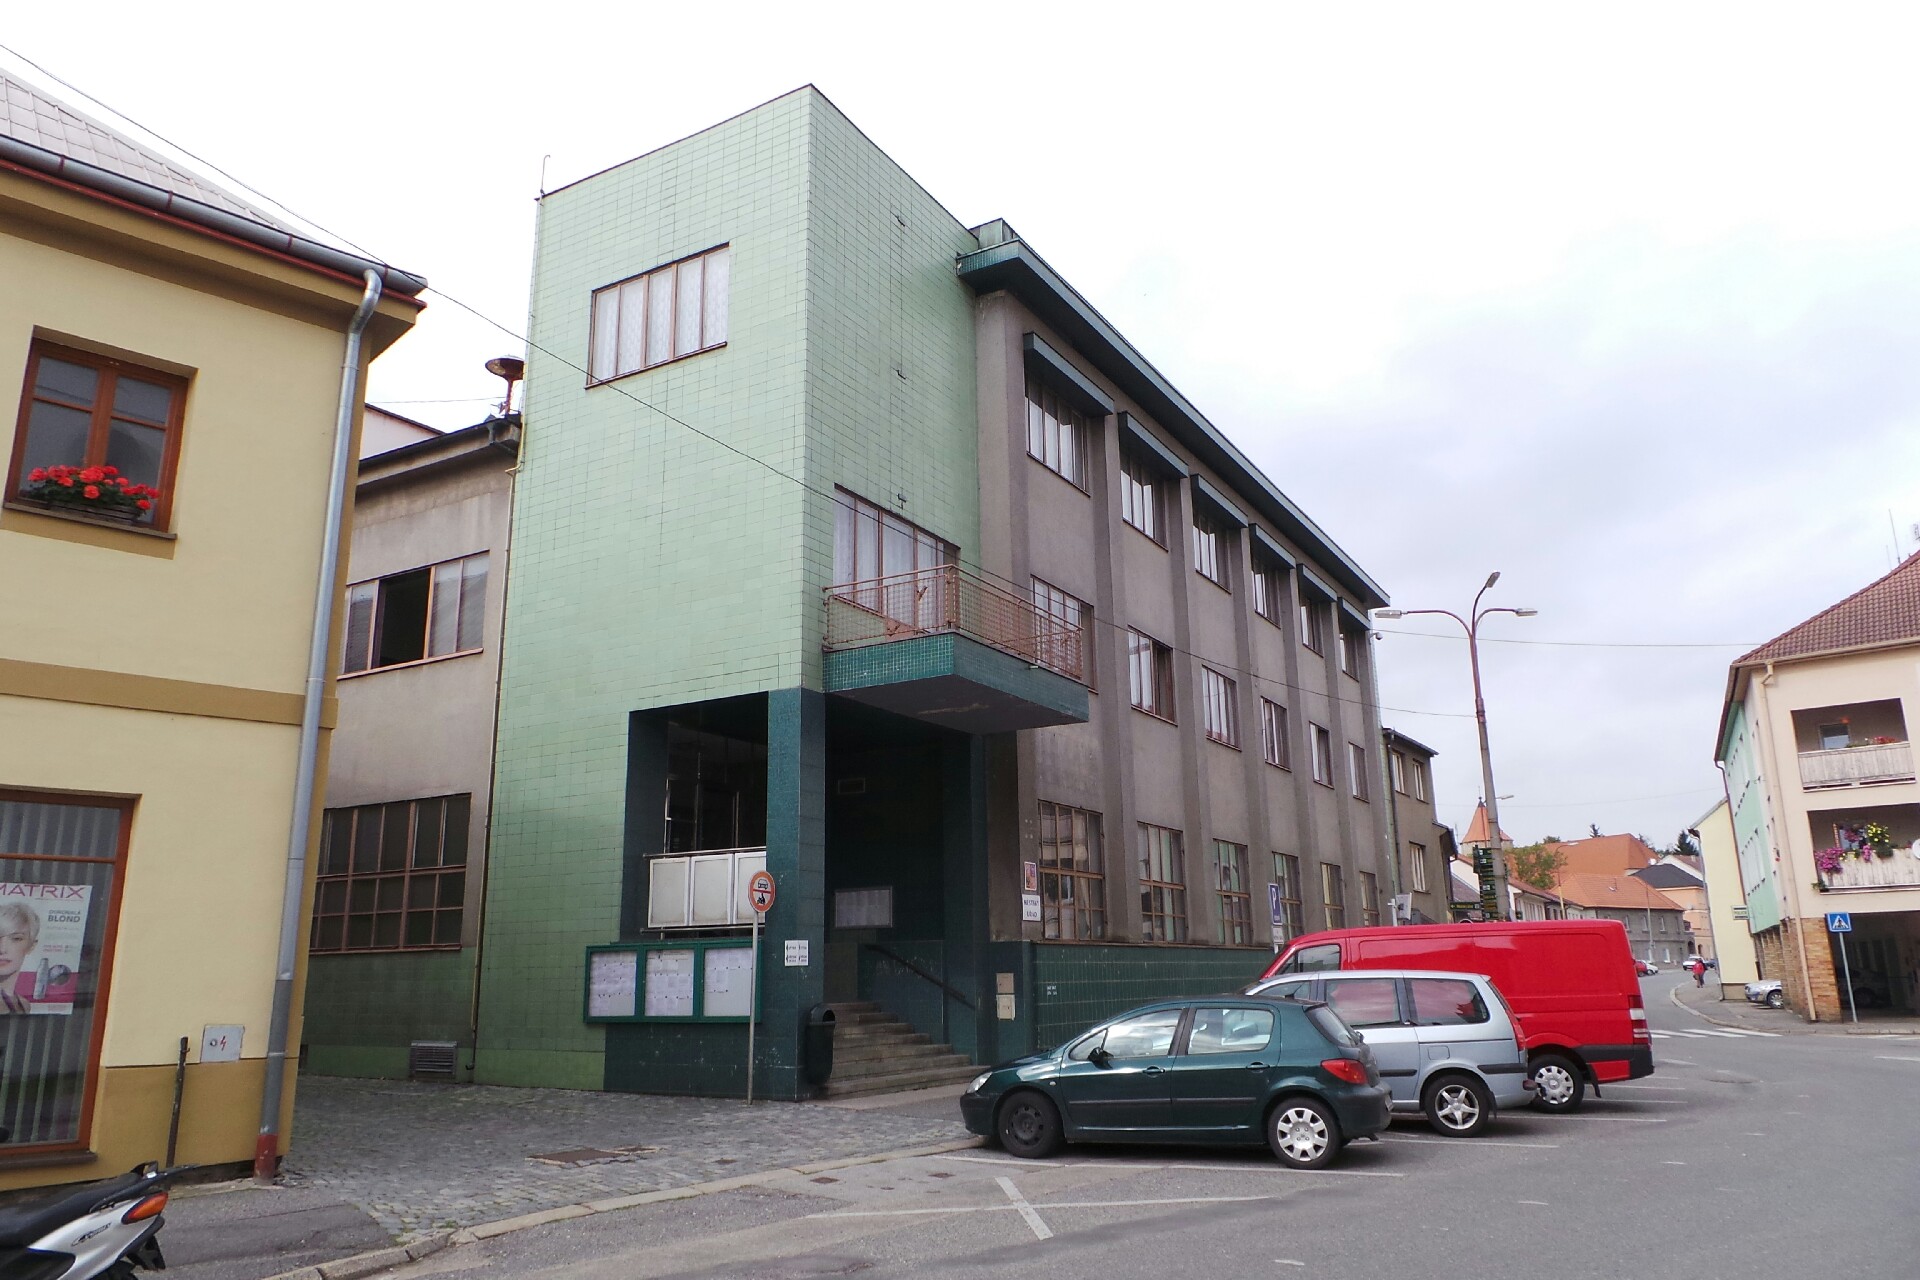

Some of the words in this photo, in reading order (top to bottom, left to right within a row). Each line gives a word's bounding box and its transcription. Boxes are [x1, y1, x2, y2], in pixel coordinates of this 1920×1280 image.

[0, 883, 84, 899] MATRIX
[1271, 887, 1277, 910] P
[48, 914, 81, 923] BLOND
